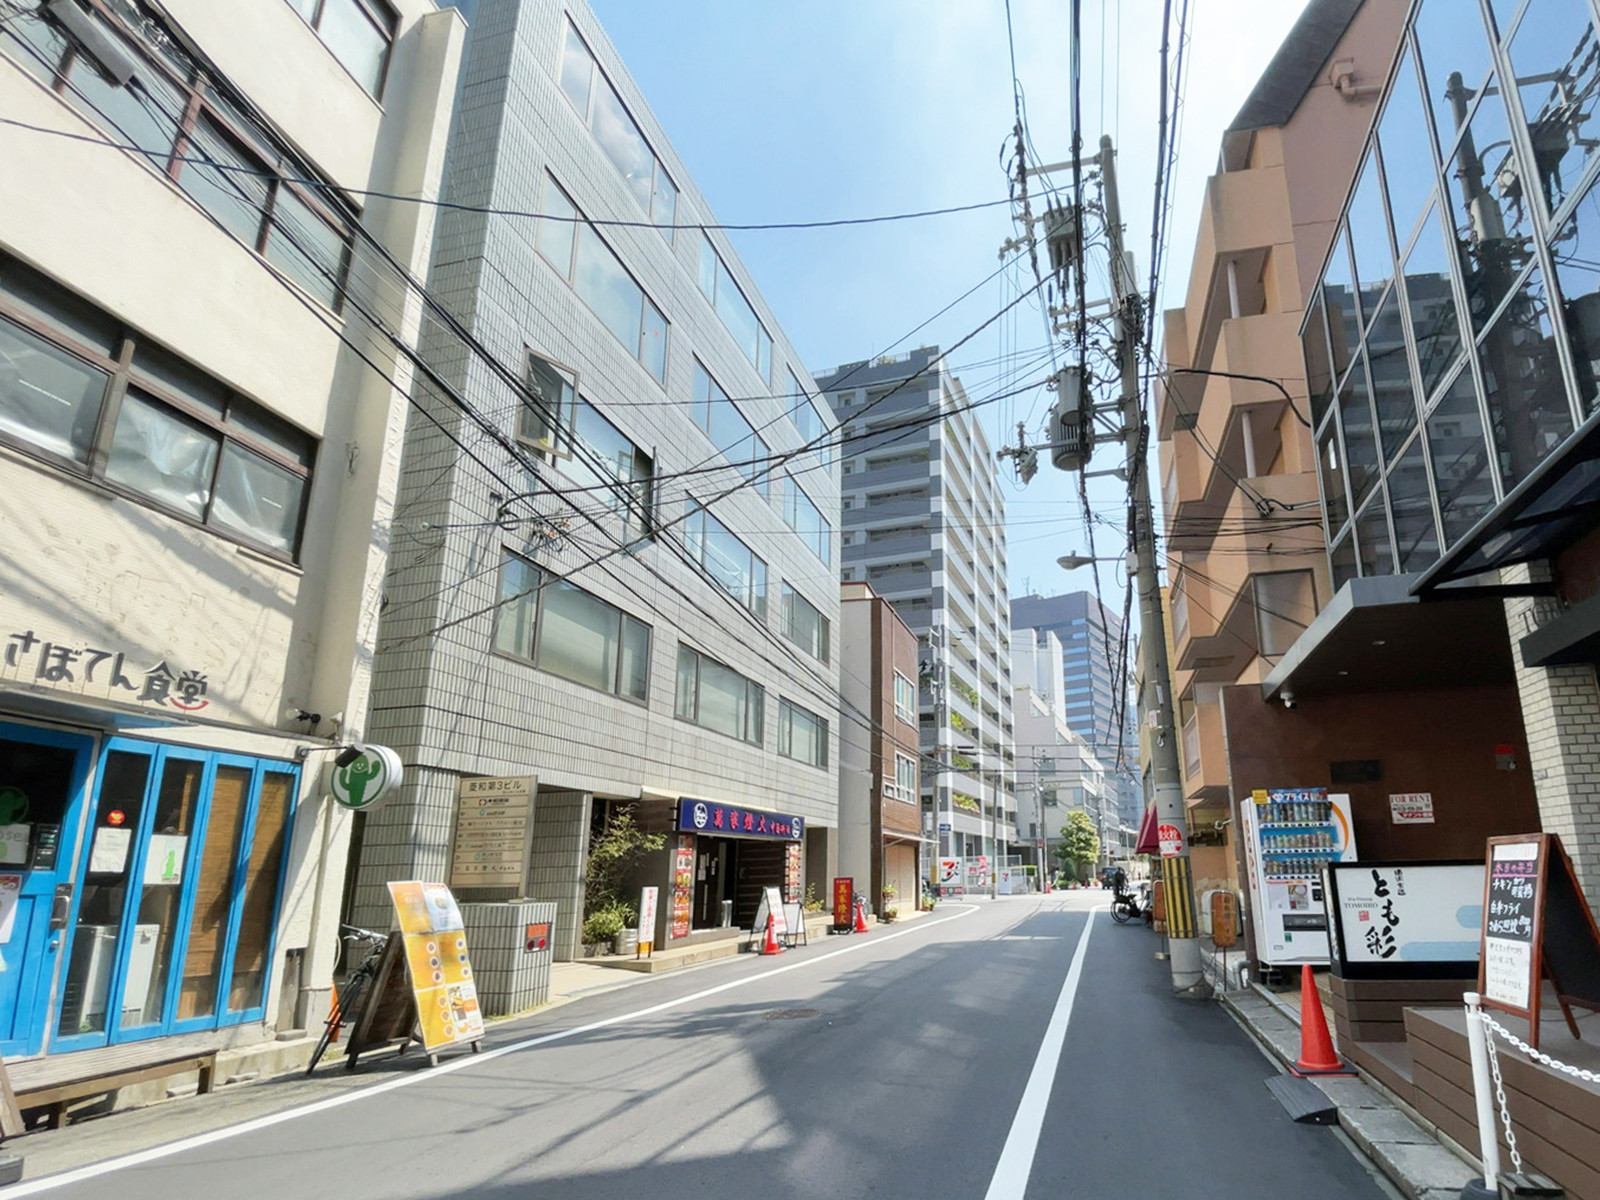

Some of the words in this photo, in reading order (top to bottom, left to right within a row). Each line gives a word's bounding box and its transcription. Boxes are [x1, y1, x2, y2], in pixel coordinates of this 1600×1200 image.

[5, 630, 208, 706] さぼてん食堂
[1365, 869, 1400, 958] とも彩
